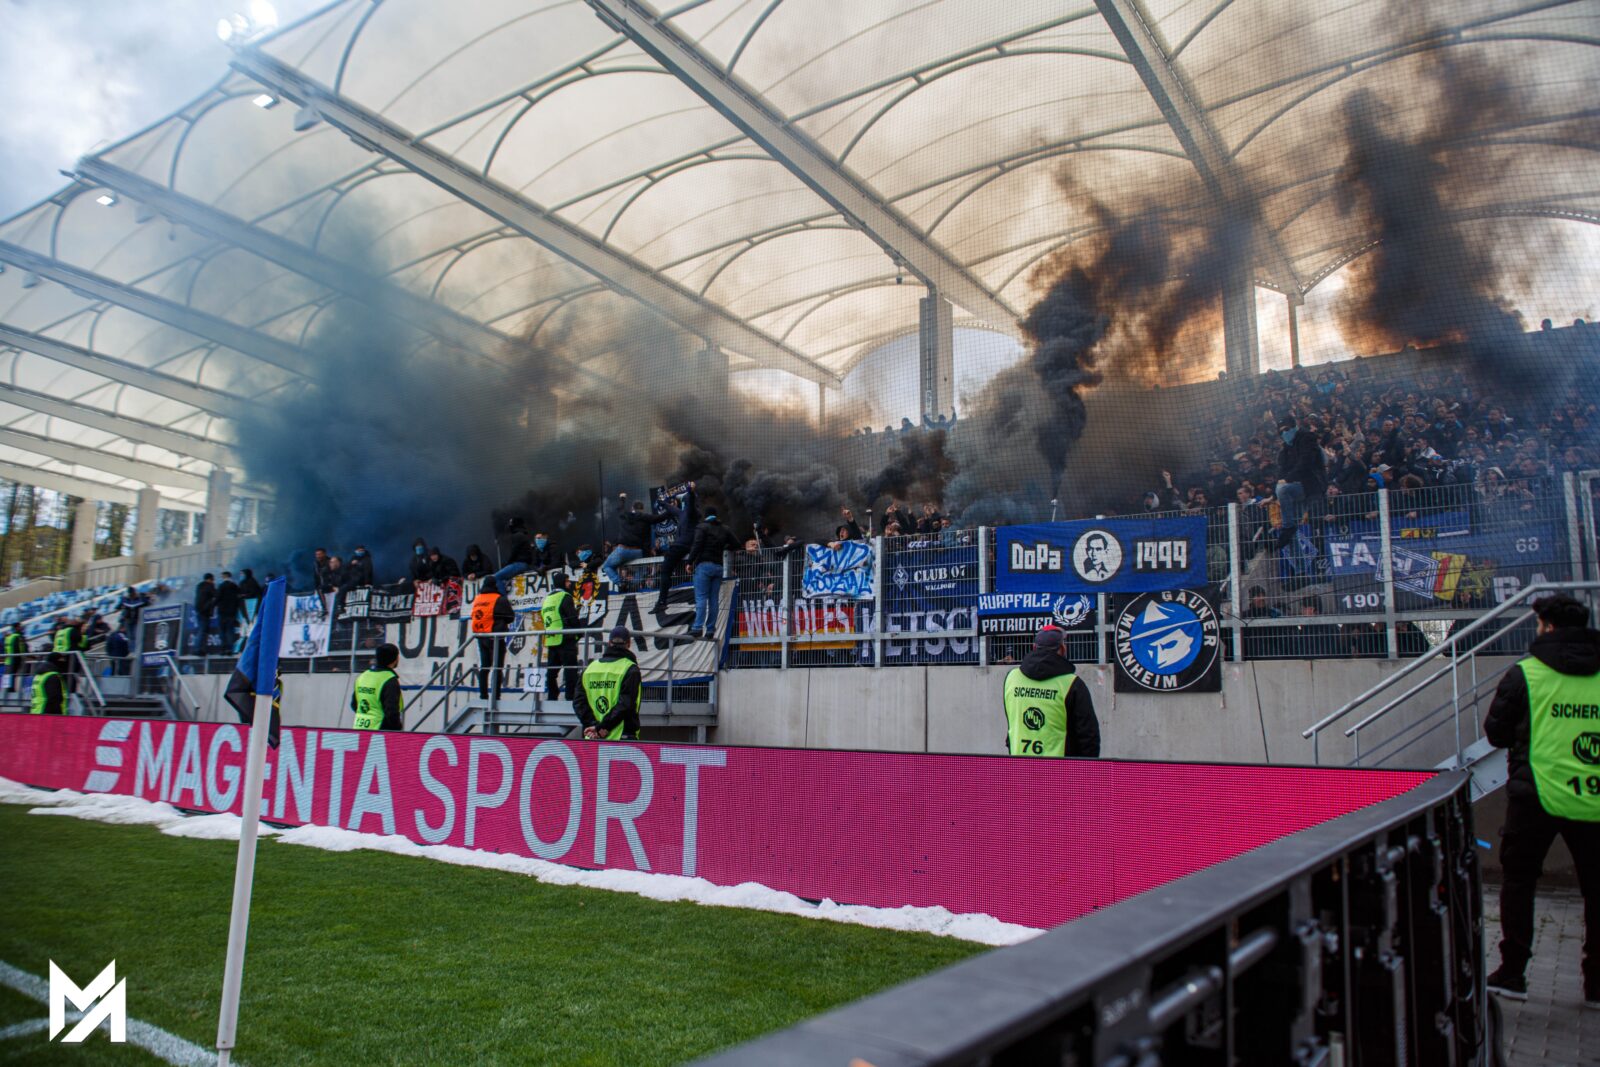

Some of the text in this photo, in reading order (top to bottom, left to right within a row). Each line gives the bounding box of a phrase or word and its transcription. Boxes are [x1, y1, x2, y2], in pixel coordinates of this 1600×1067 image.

[1011, 540, 1188, 571] DoPa 1999
[1328, 542, 1377, 568] FA
[913, 564, 967, 583] CLUB 07
[978, 592, 1052, 611] KURPFALZ
[1342, 592, 1386, 609] 190
[1161, 590, 1217, 648] GAUNER
[1117, 612, 1178, 690] MANNHEIM
[527, 674, 542, 688] C2
[1013, 686, 1059, 700] SICHERHEIT
[1550, 702, 1600, 719] SICHER
[1020, 739, 1044, 755] 76
[413, 734, 728, 878] SPORT
